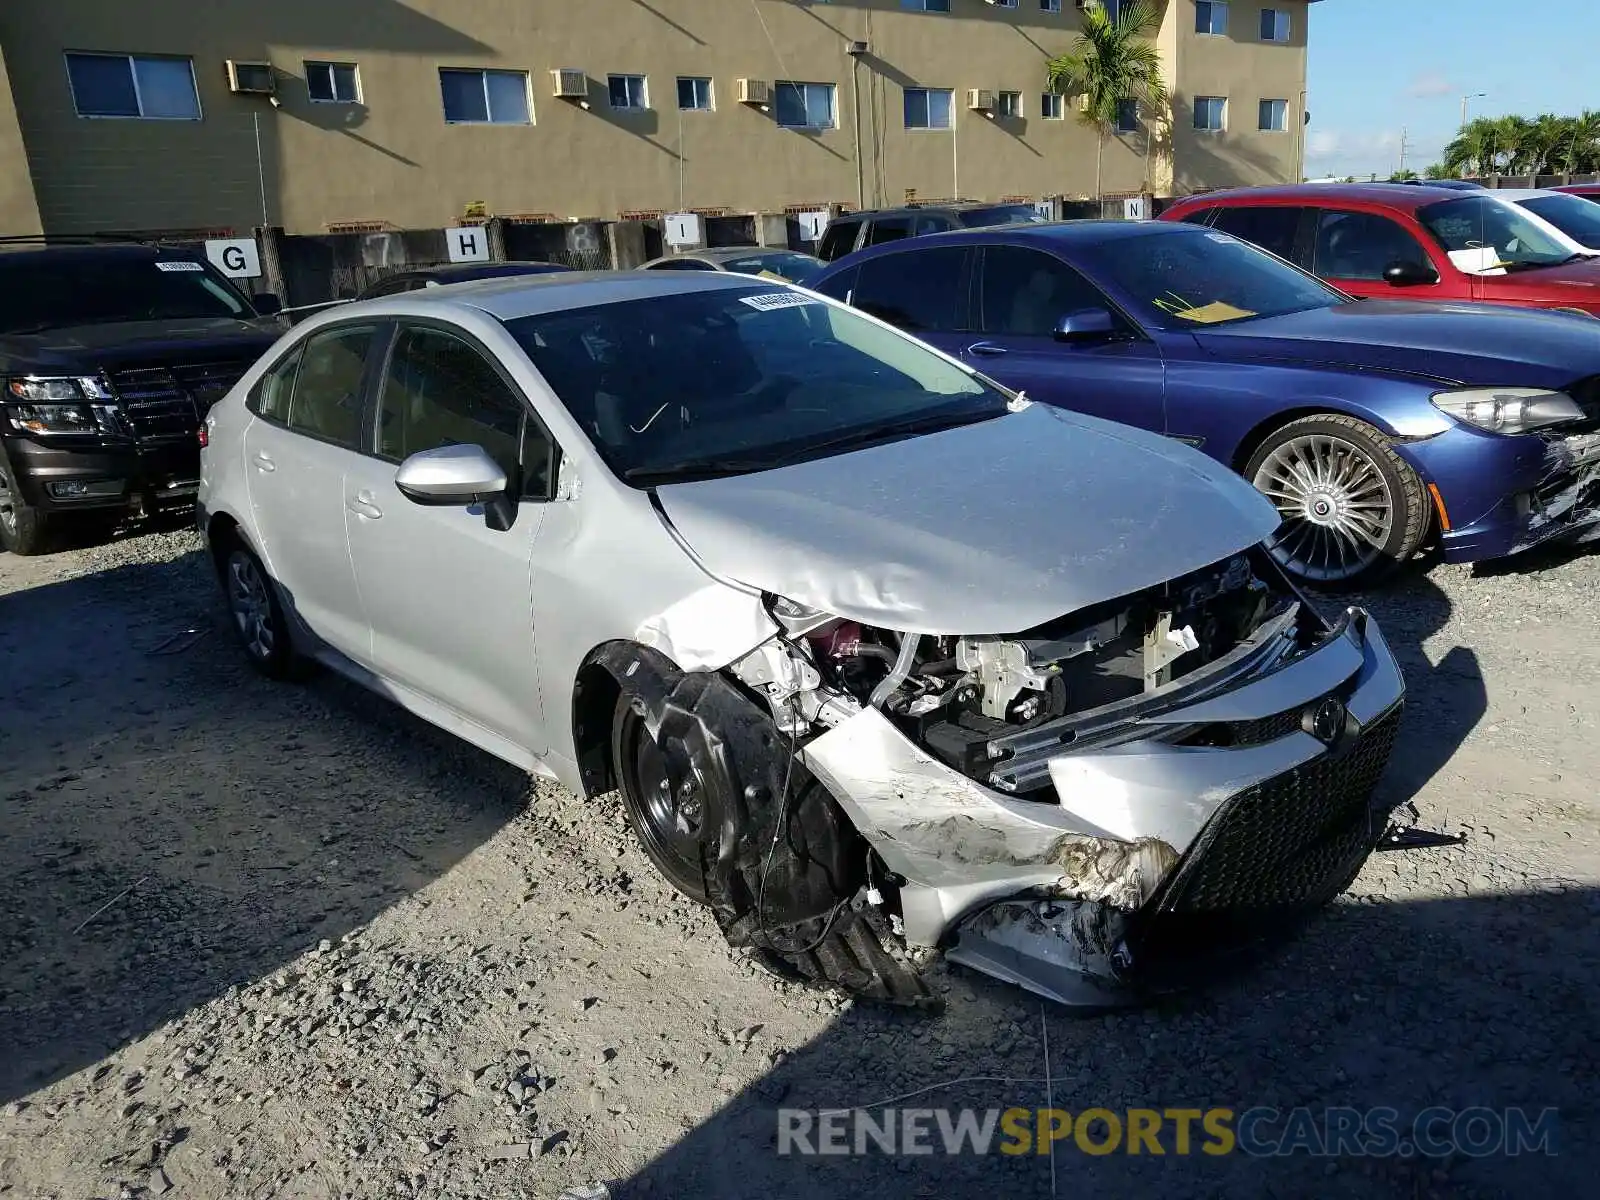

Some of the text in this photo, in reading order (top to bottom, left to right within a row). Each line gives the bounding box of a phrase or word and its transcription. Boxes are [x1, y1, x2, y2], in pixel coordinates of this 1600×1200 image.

[1040, 207, 1049, 221] M
[1130, 203, 1138, 216] N
[366, 233, 391, 266] 7
[459, 234, 477, 255] H
[223, 246, 247, 271] G
